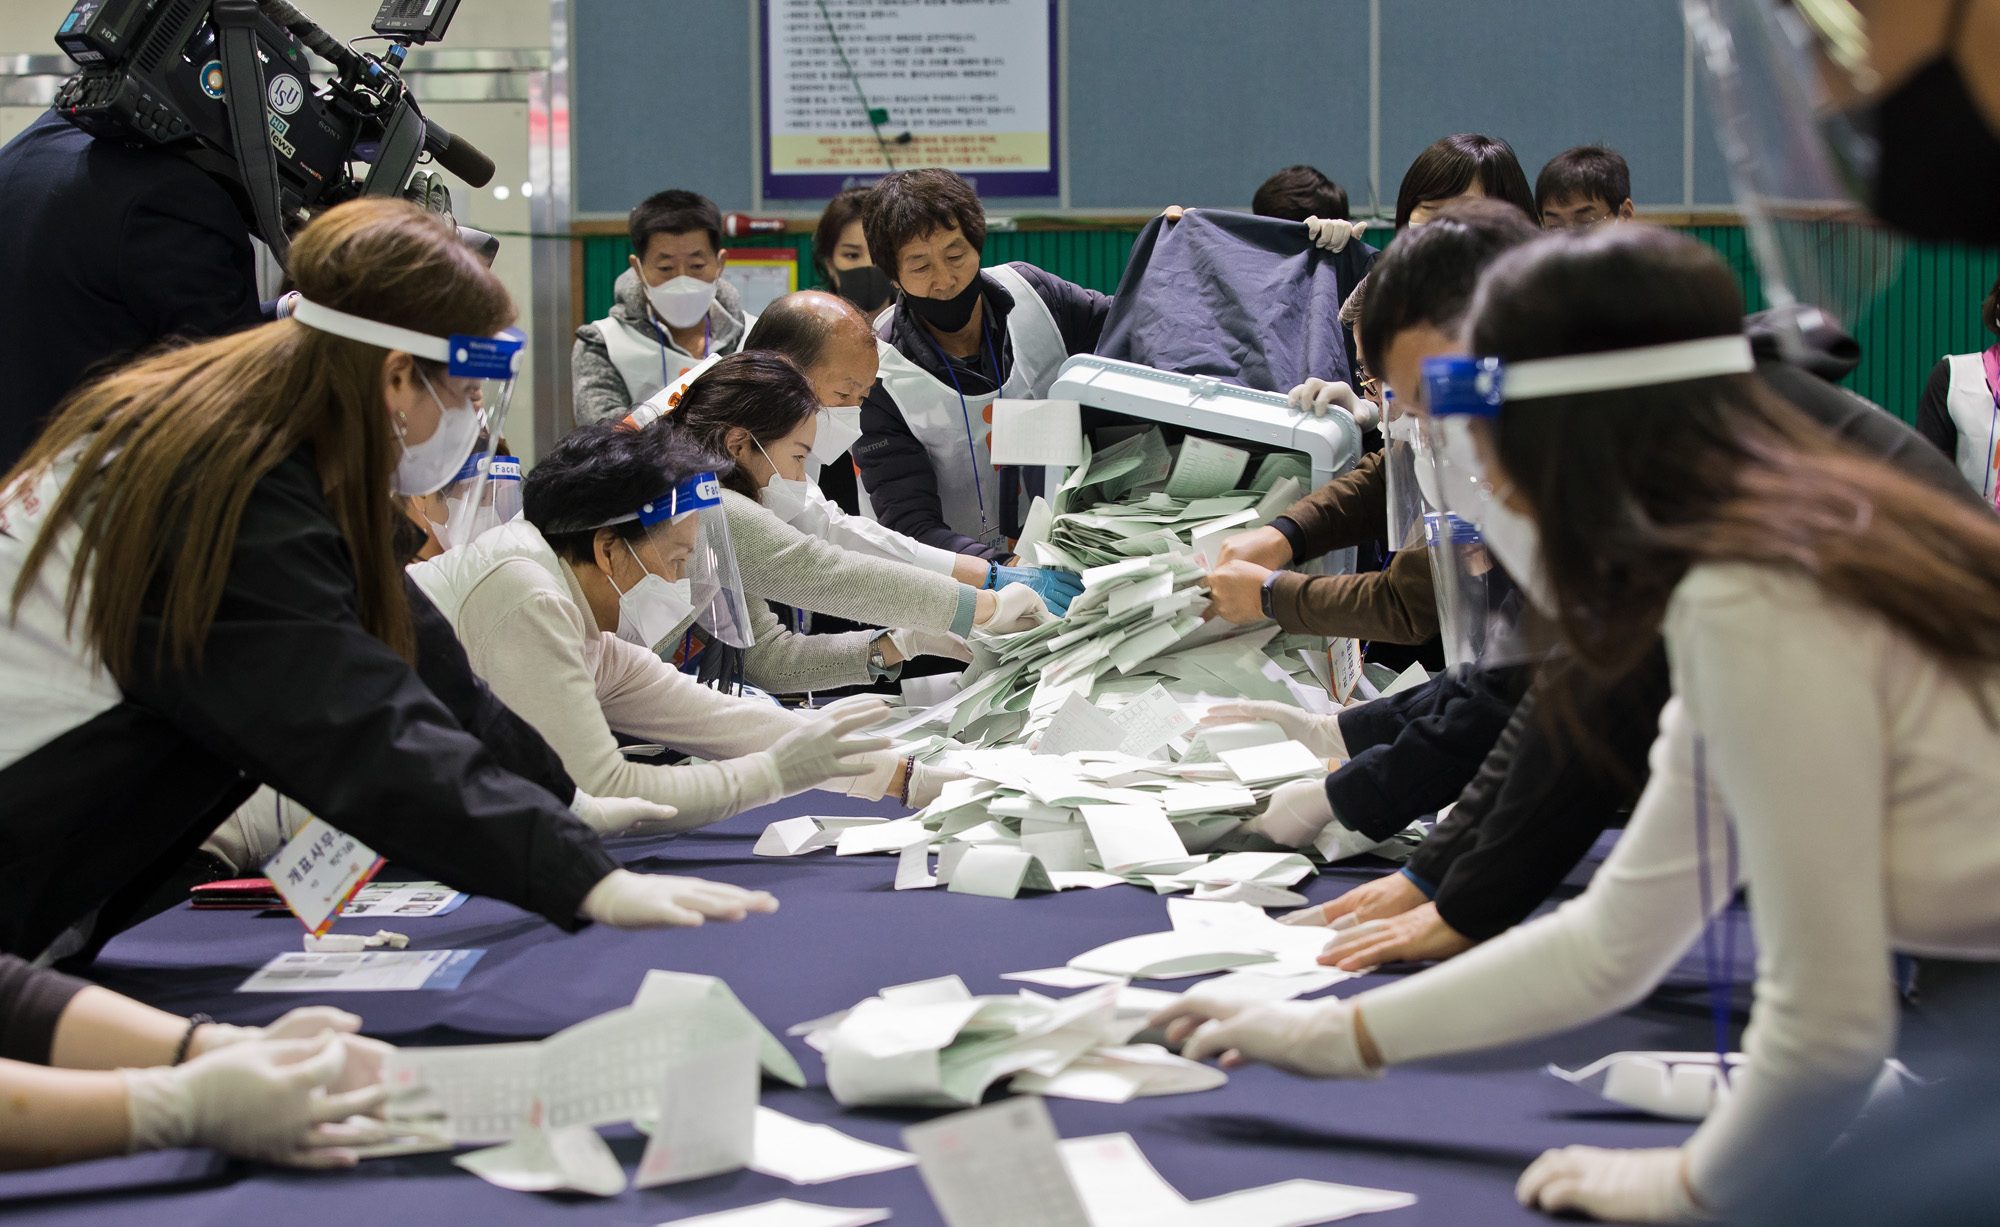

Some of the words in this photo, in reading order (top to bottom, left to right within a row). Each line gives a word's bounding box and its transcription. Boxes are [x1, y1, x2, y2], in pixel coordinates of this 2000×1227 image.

[274, 79, 299, 107] ISU
[270, 115, 287, 134] HD
[318, 120, 341, 141] SONY
[270, 130, 294, 156] ews
[495, 464, 514, 474] Face
